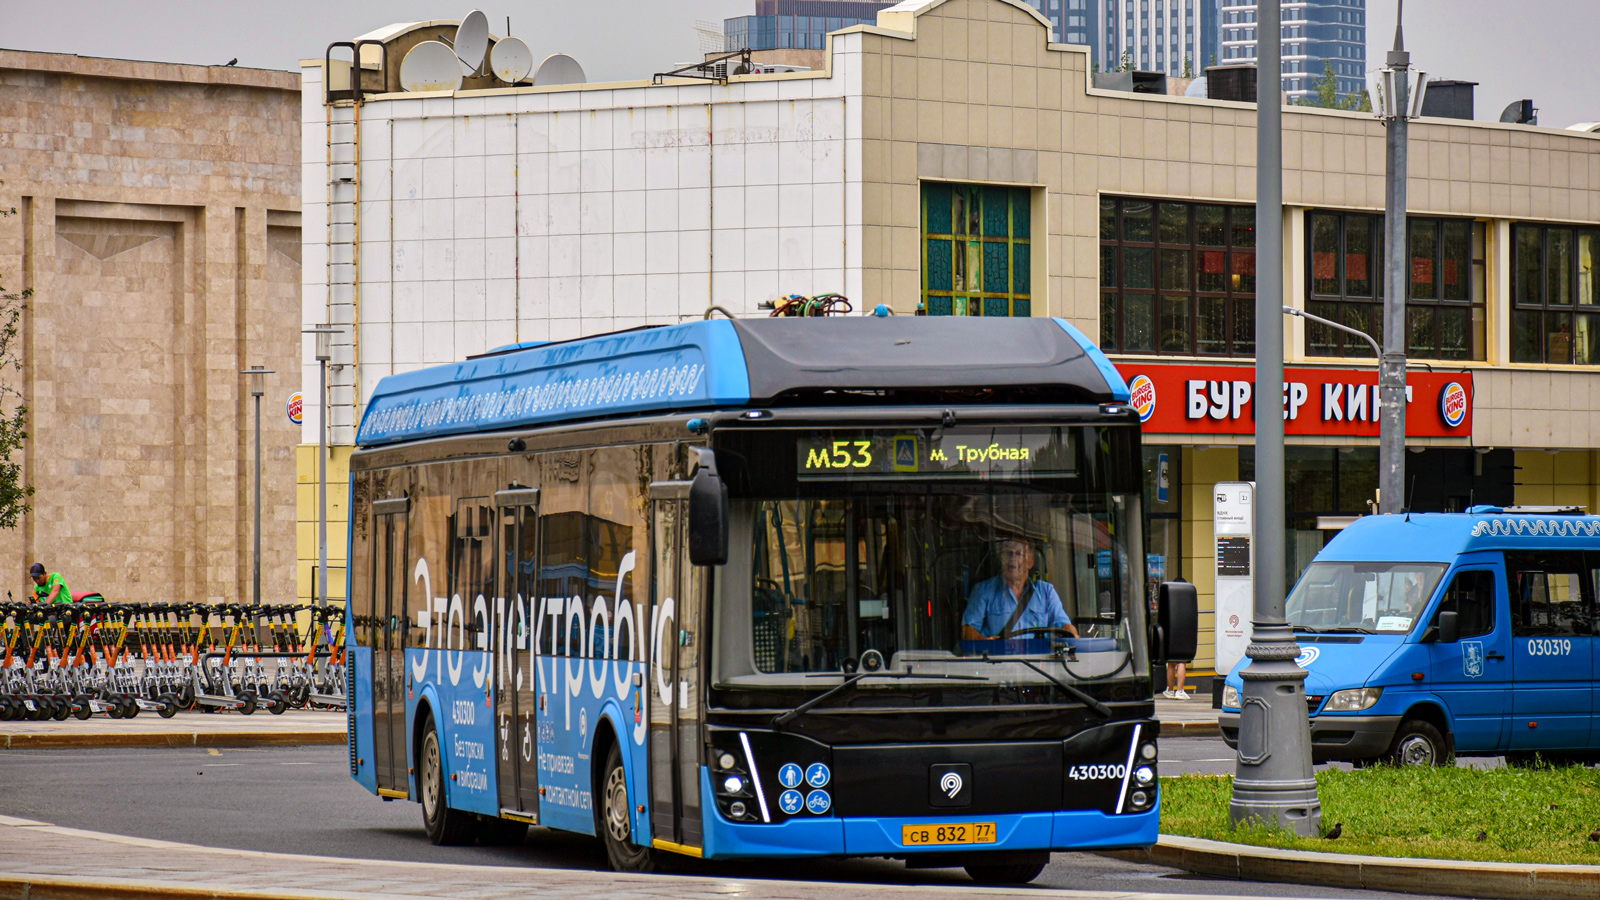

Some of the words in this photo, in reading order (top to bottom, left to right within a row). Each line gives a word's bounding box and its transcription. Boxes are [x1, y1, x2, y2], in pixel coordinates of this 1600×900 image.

[1131, 382, 1152, 401] BURGER
[1133, 390, 1153, 410] KING
[1188, 379, 1308, 420] БУРР
[1445, 390, 1464, 406] BURGER
[289, 405, 302, 419] KIN
[1446, 398, 1464, 416] KING
[955, 442, 1030, 463] Трубная
[412, 557, 464, 688] Это
[1528, 638, 1572, 656] 030319
[452, 700, 475, 726] 430300
[454, 733, 465, 758] Без
[465, 740, 485, 764] тряски
[538, 745, 547, 771] Не
[547, 753, 575, 778] привязан
[460, 764, 488, 794] вибраций
[1068, 764, 1126, 781] 430300
[545, 783, 580, 807] контактной
[910, 830, 929, 843] СВ
[936, 826, 966, 842] 832
[975, 824, 991, 837] 77
